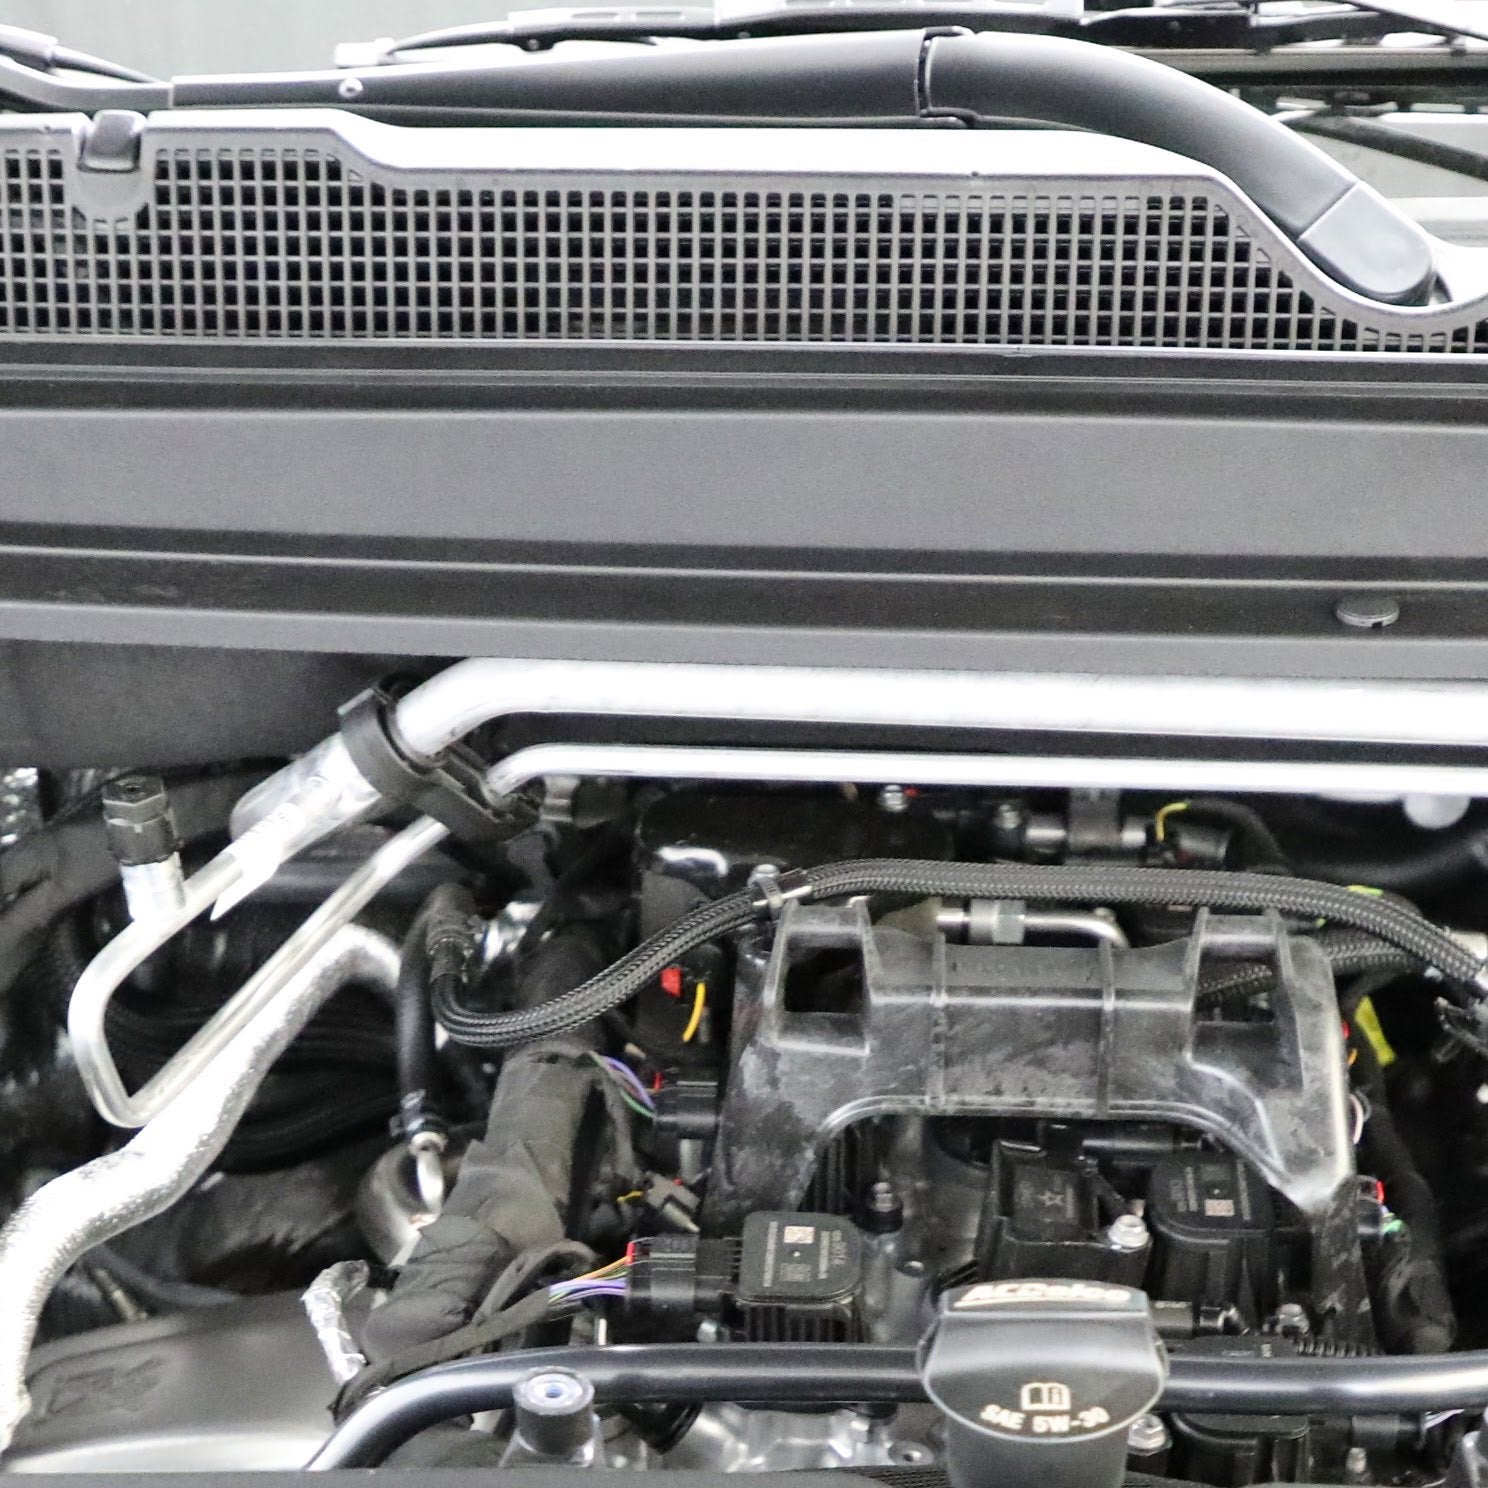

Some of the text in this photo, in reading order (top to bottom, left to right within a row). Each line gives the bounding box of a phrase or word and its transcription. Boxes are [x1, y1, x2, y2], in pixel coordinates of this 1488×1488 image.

[955, 1282, 1132, 1306] ACDelco
[979, 1403, 1112, 1433] SAE 5W-30
